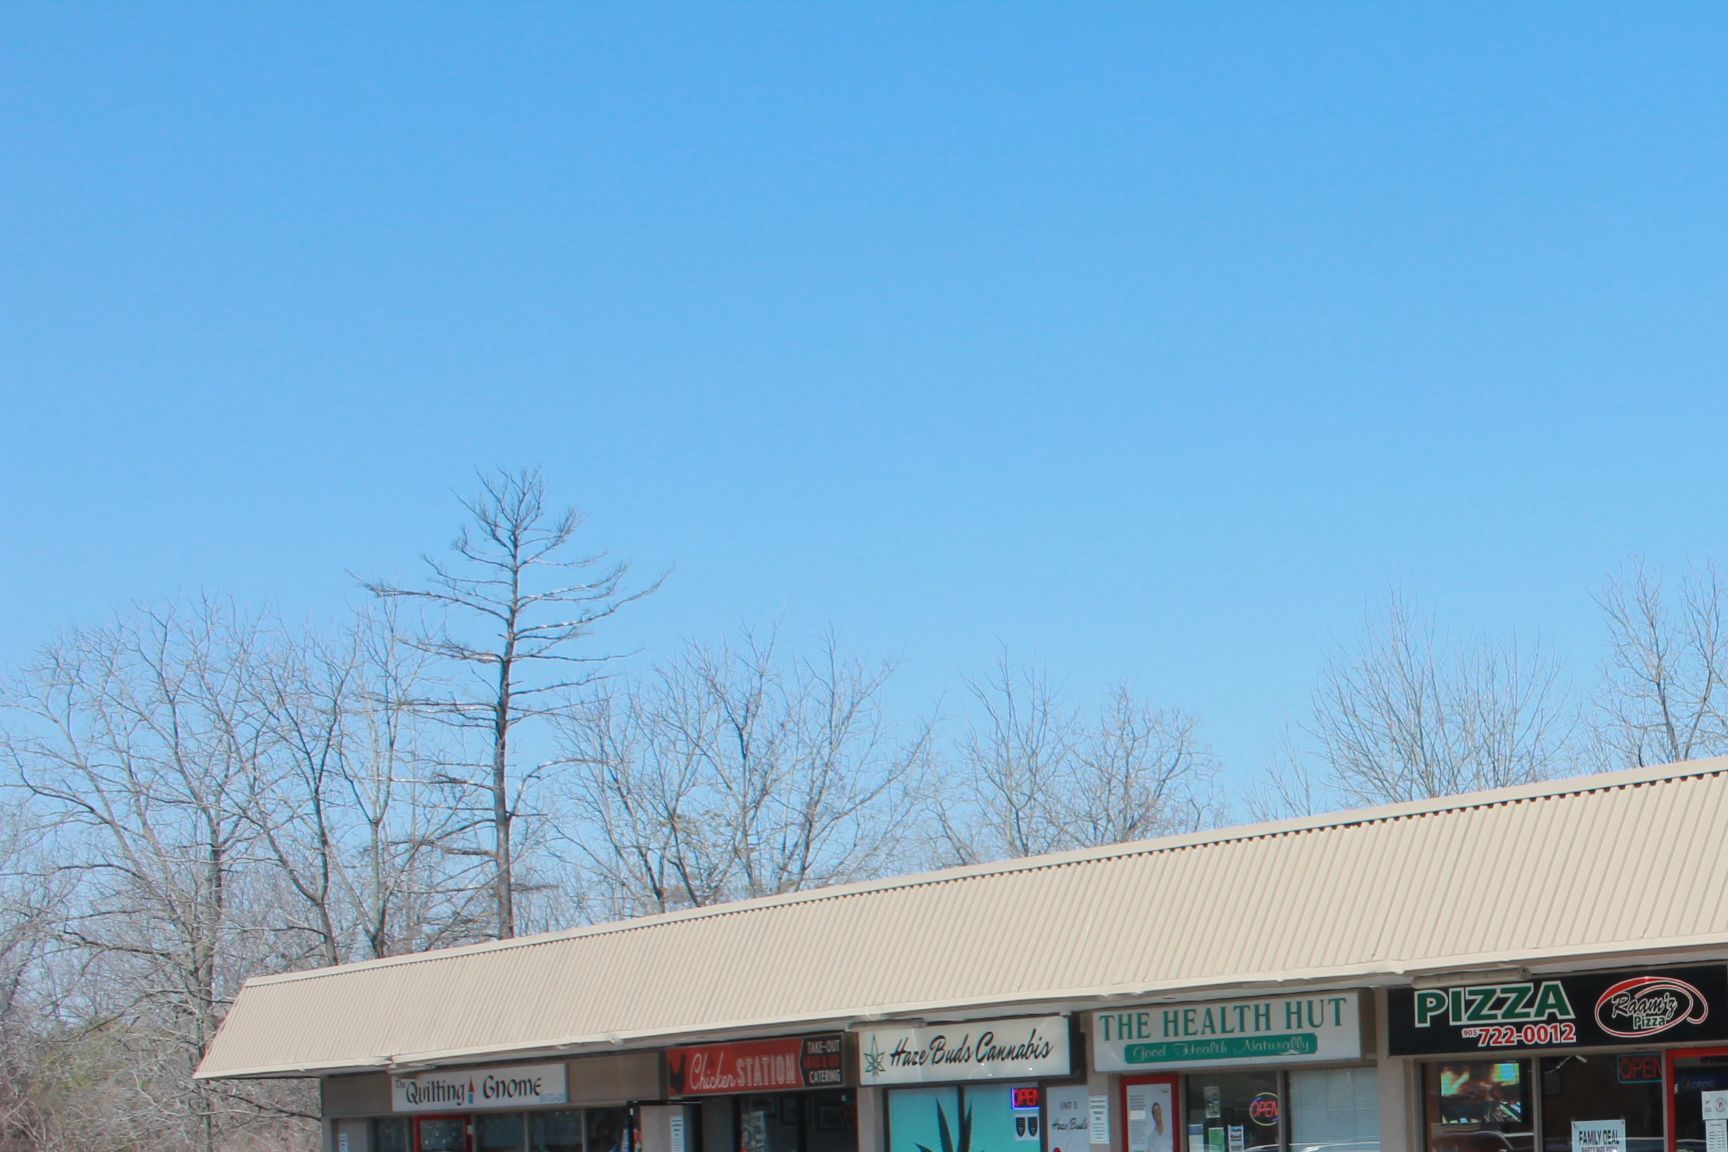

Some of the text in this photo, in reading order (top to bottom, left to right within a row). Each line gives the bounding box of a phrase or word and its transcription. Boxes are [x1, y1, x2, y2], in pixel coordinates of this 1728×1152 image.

[1414, 980, 1576, 1028] PIZZA
[1611, 991, 1679, 1019] Raam'z
[1099, 997, 1348, 1042] THE HEALTH HUT
[1632, 1016, 1666, 1030] Pizza
[807, 1040, 840, 1054] TAKE-OUT
[890, 1027, 1053, 1067] Haze Buds Cannabis
[1462, 1023, 1576, 1047] 905 722-0012
[1132, 1035, 1311, 1062] Good Health Naturally
[689, 1050, 796, 1091] Chicken STATION
[809, 1069, 841, 1084] CATERING
[1619, 1055, 1662, 1080] OPEN
[396, 1075, 541, 1106] The Quilting Gnome
[1014, 1088, 1039, 1108] OPEN
[1251, 1100, 1280, 1118] OPEN
[1579, 1129, 1620, 1146] FAMILY DEAL
